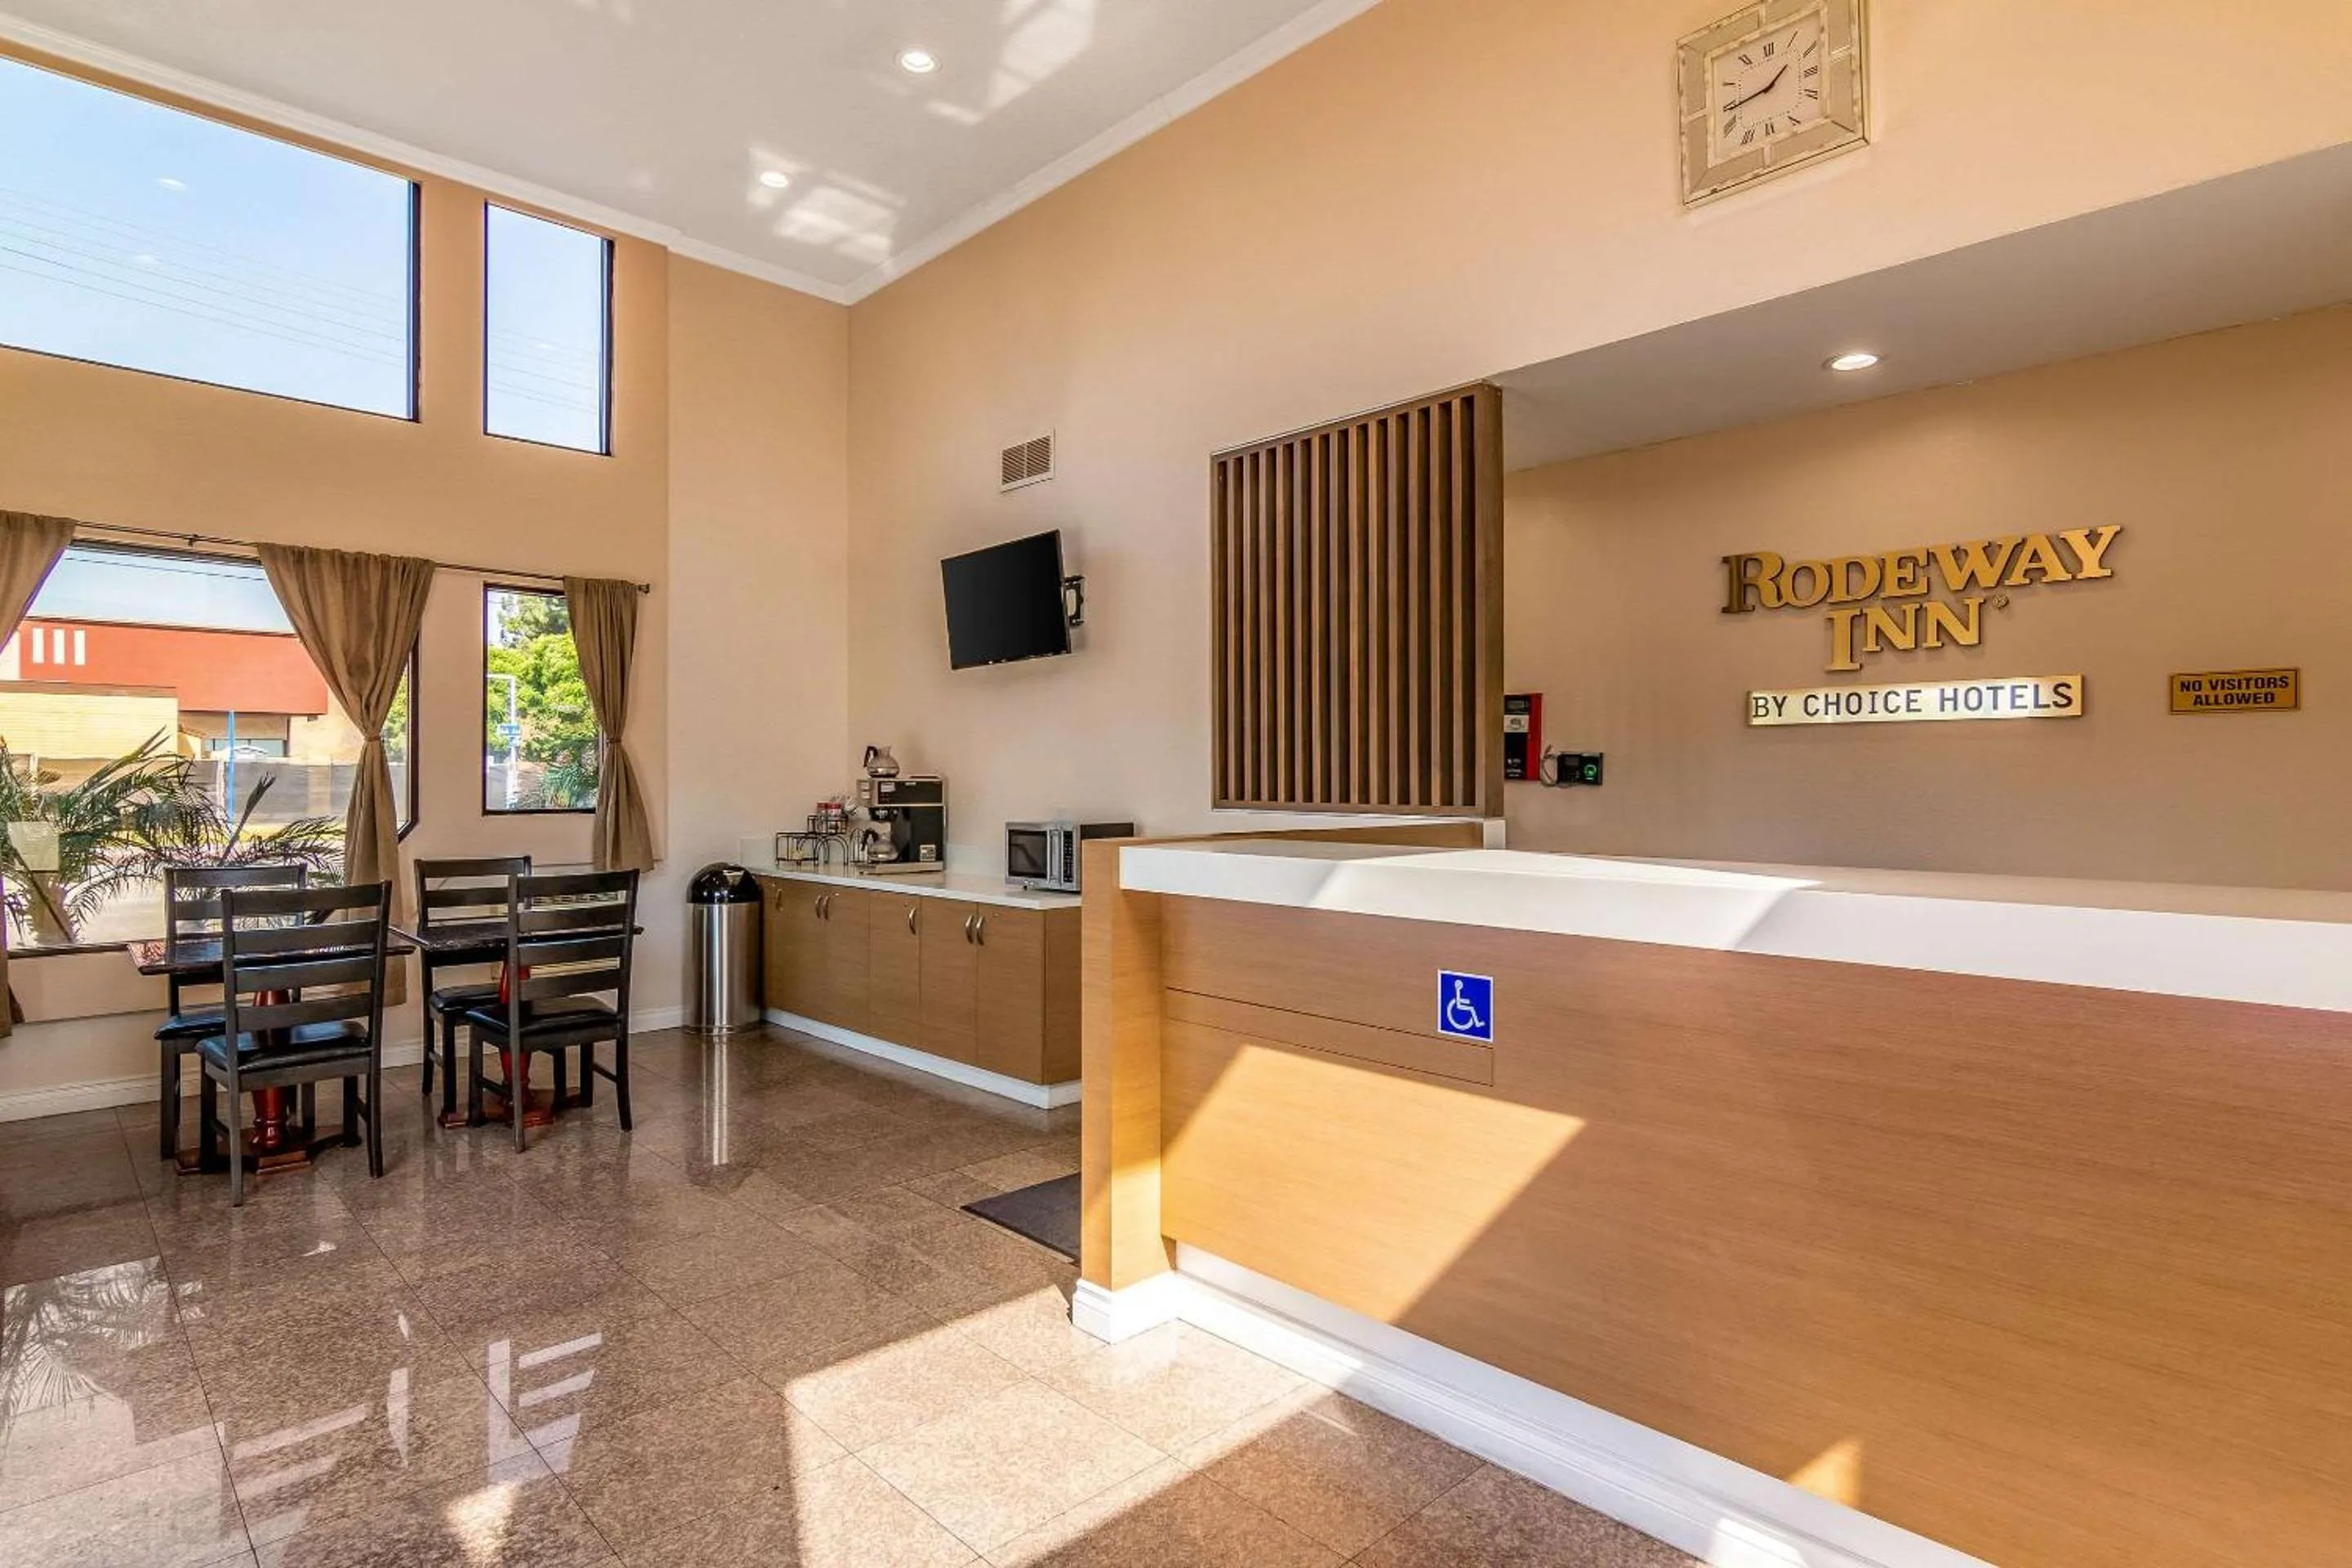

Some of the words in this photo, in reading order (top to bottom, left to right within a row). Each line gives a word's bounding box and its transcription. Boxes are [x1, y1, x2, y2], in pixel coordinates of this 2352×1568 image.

[1721, 525, 2122, 614] RODEWAY
[1824, 597, 1986, 672] INN
[1752, 695, 1788, 719] BY
[1803, 689, 1922, 717] CHOICE
[1939, 683, 2074, 713] HOTELS
[2180, 680, 2203, 693] NO
[2208, 676, 2289, 691] VISITORS
[2193, 692, 2274, 706] ALLOWED
